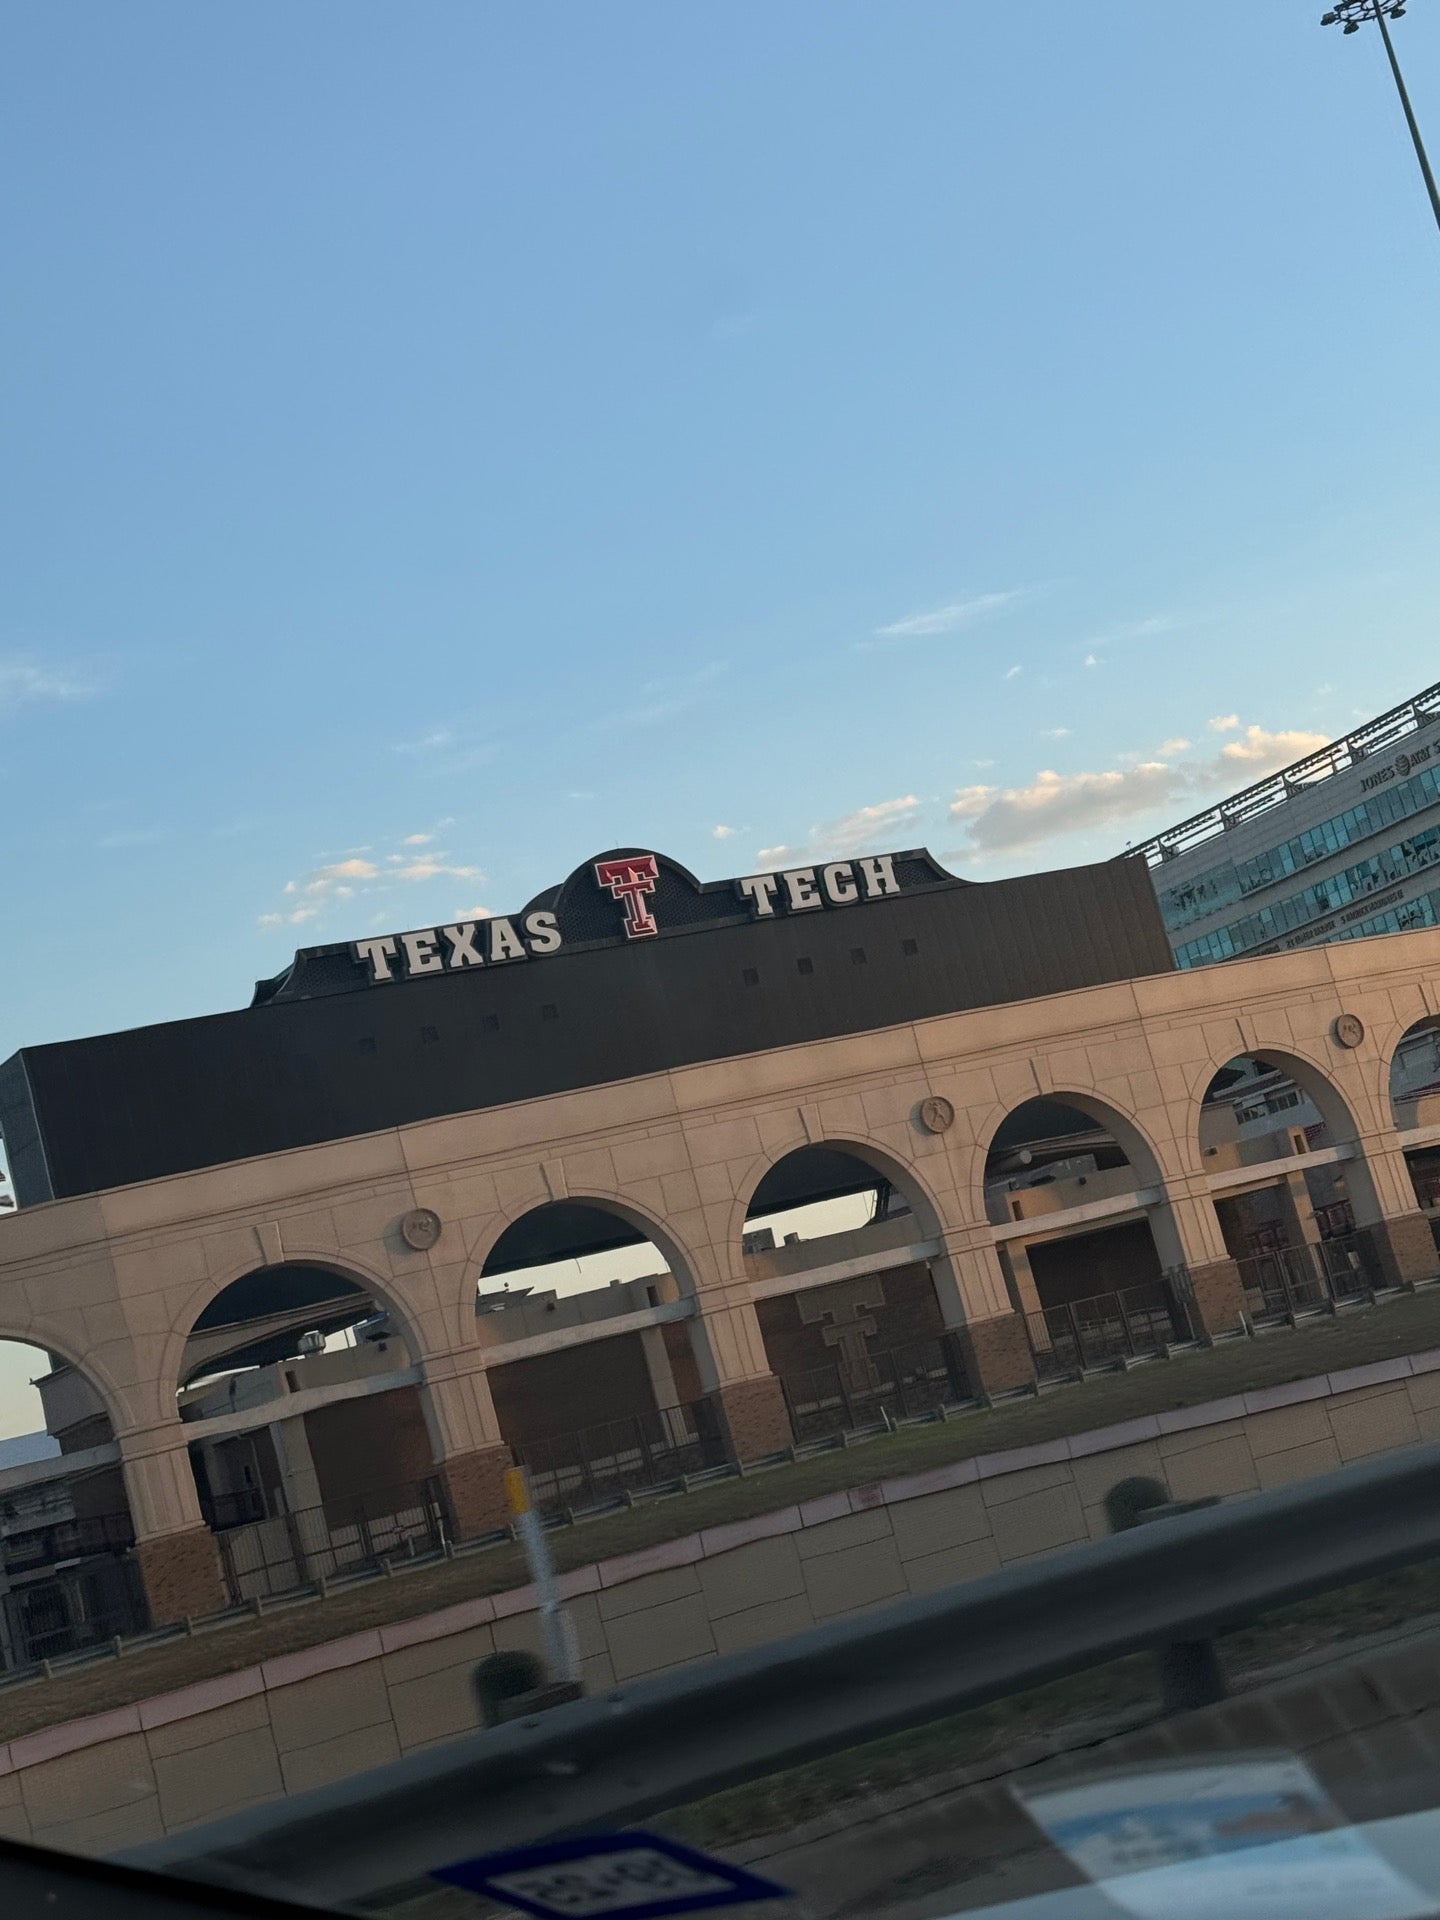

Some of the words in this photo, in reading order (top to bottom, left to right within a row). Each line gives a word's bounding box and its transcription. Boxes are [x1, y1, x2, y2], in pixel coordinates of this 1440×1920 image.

[1361, 765, 1396, 793] JONES
[356, 911, 562, 981] TEXAS
[741, 855, 901, 917] TECH
